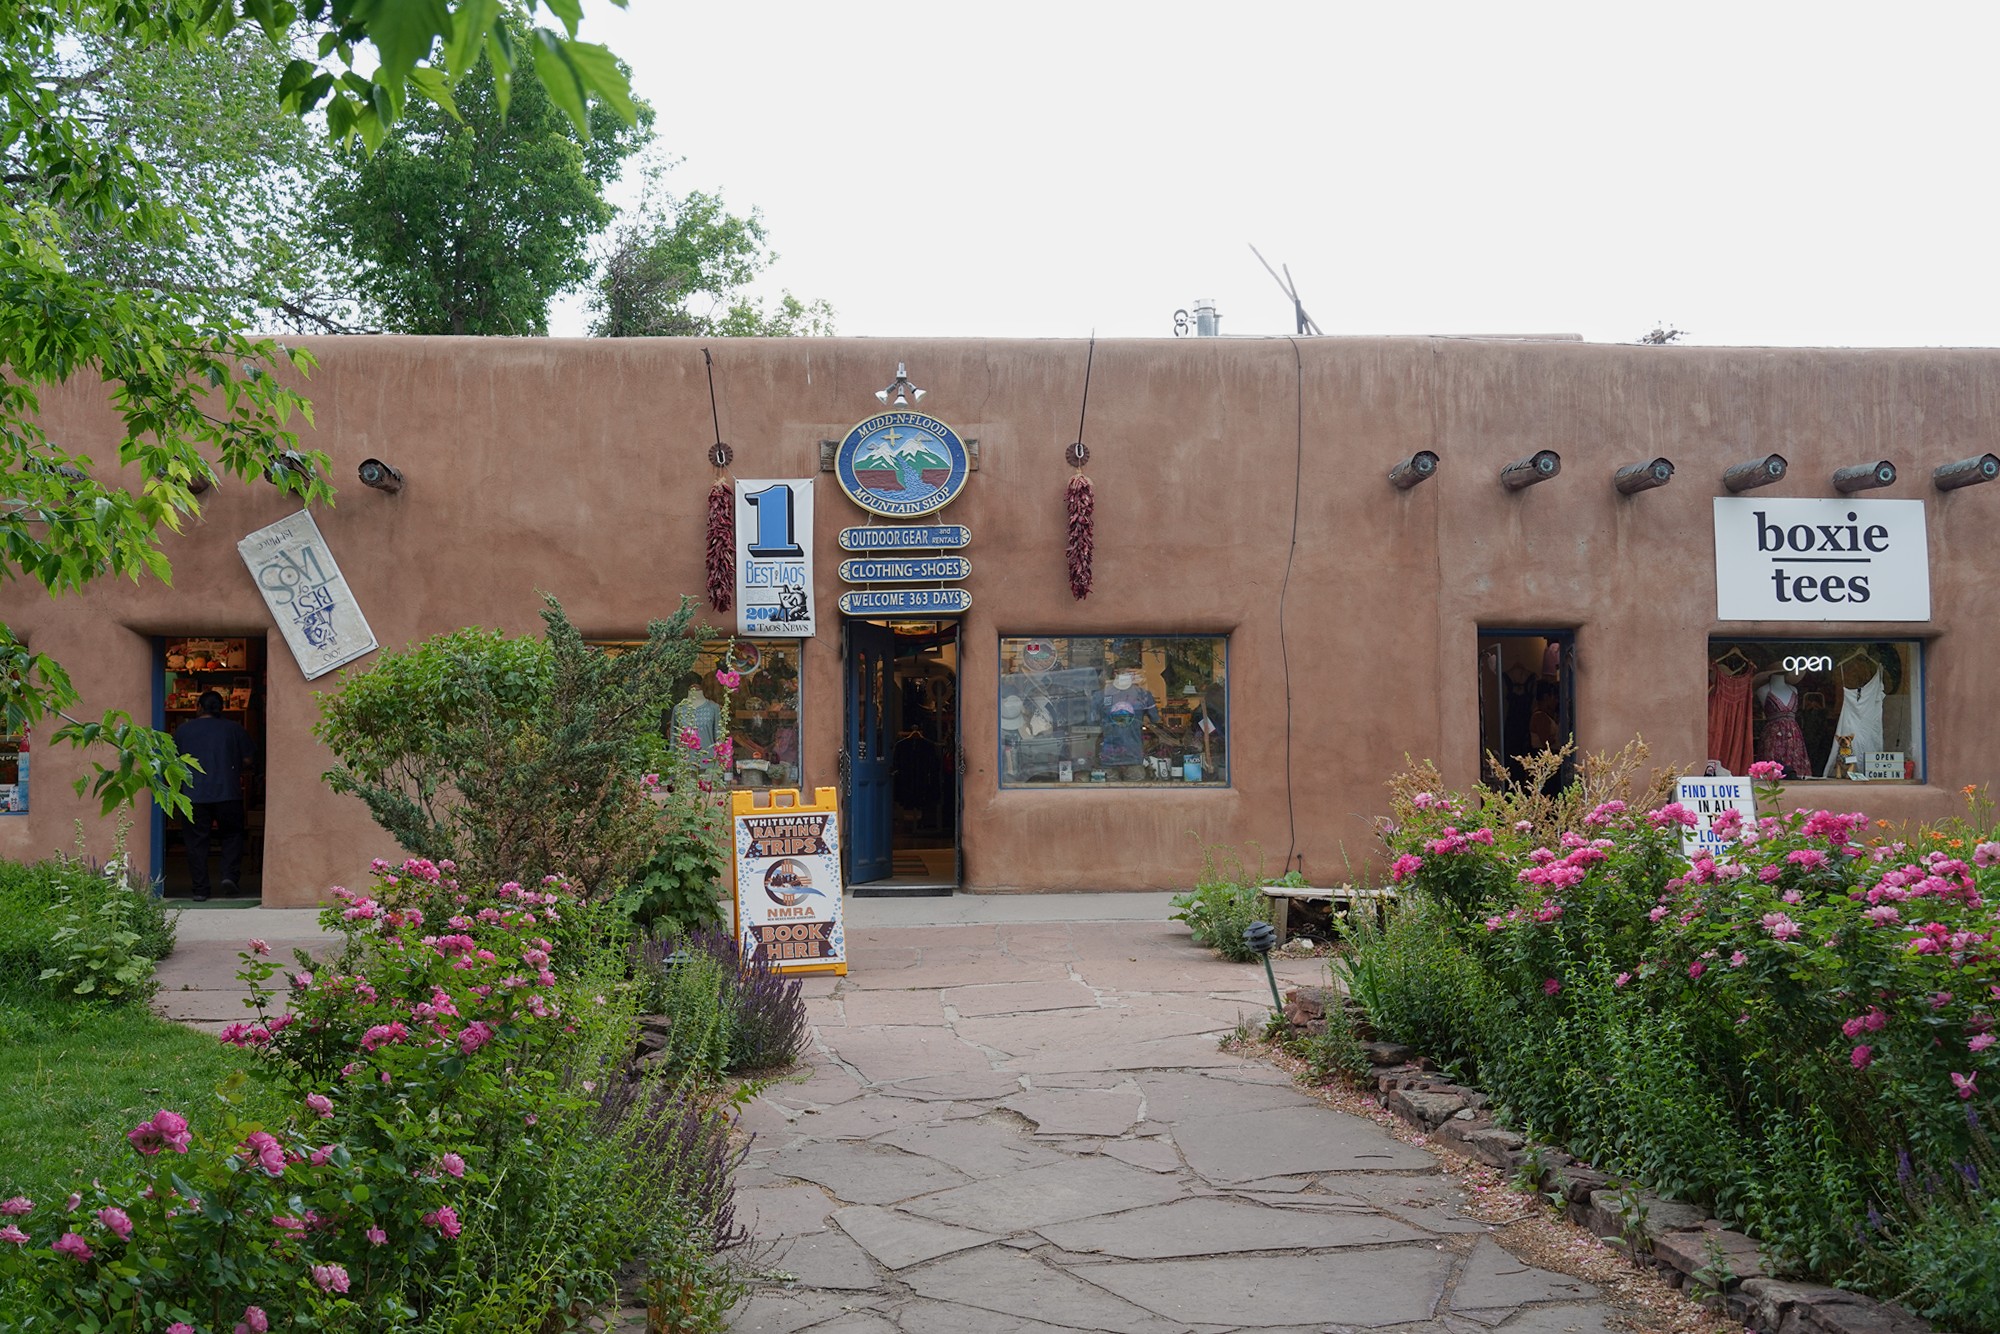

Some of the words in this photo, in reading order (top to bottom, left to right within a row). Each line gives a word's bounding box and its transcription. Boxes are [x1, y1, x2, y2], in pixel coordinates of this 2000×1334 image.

[857, 414, 948, 438] MUDD-N-FLOOD
[853, 487, 920, 513] MOUNTAIN
[922, 486, 950, 510] SHOP
[744, 484, 804, 557] 1
[851, 531, 900, 546] OUTDOOR
[902, 530, 929, 545] GEAR
[932, 536, 959, 545] RENTALS
[1753, 511, 1890, 553] boxie
[258, 546, 339, 605] TAOS
[746, 560, 774, 588] BEST
[774, 561, 806, 586] TAOS
[1771, 568, 1871, 603] tees
[291, 586, 333, 619] BEST
[851, 593, 905, 607] WELCOME
[909, 592, 929, 606] 363
[933, 591, 960, 605] DAYS
[757, 623, 781, 632] TAOS
[783, 623, 809, 633] NEWS
[1782, 655, 1832, 676] open
[1875, 753, 1895, 761] OPEN
[1681, 785, 1706, 798] FIND
[1712, 785, 1740, 798] LOVE
[1698, 800, 1709, 812] IN
[748, 816, 823, 827] WHITEWATER
[753, 824, 820, 839] RAFTING
[759, 837, 817, 856] TRIPS
[767, 907, 815, 917] NMRA
[762, 923, 826, 943] BOOK
[767, 941, 820, 960] HERE
